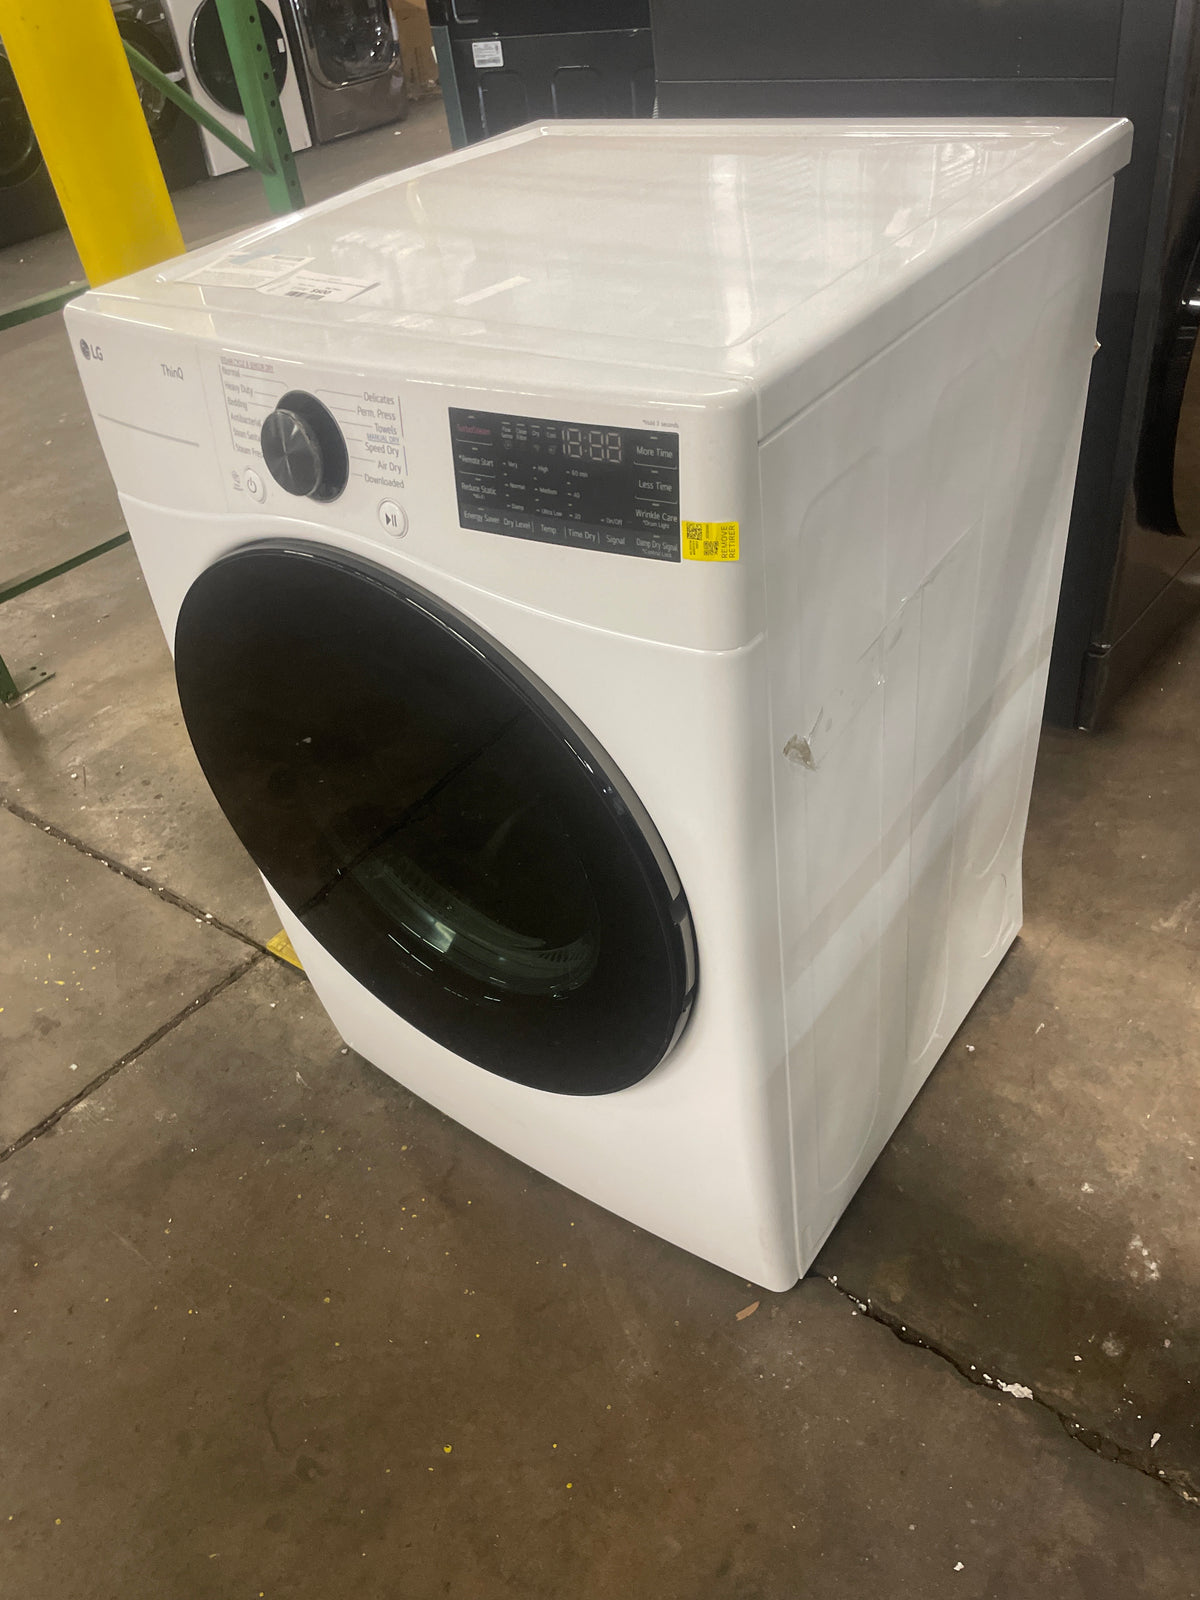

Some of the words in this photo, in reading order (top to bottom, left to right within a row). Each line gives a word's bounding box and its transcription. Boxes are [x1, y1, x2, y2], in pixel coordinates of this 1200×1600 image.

[90, 344, 104, 361] LG
[160, 363, 184, 380] ThinQ
[240, 384, 253, 398] Duty
[363, 392, 395, 406] Delicates
[357, 406, 375, 419] Perm.
[377, 408, 396, 420] Press
[374, 422, 397, 435] Towels
[364, 442, 386, 454] Speed
[386, 445, 400, 458] Dry
[636, 445, 655, 457] More
[656, 447, 674, 459] Time
[378, 460, 388, 470] Air
[388, 462, 402, 474] Dry
[480, 458, 494, 468] Start
[364, 473, 405, 488] Downloaded
[638, 479, 654, 490] Less
[656, 481, 673, 492] Time
[480, 484, 497, 495] Static
[463, 510, 483, 522] Energy
[635, 508, 660, 520] Wrinkle
[662, 512, 678, 522] Care
[504, 518, 514, 528] Dry
[515, 520, 531, 530] Level
[568, 528, 583, 538] Time
[584, 531, 597, 542] Dry
[606, 534, 626, 546] Signal
[728, 524, 736, 558] RETIRER
[652, 540, 662, 550] Dry
[662, 542, 678, 552] Signal
